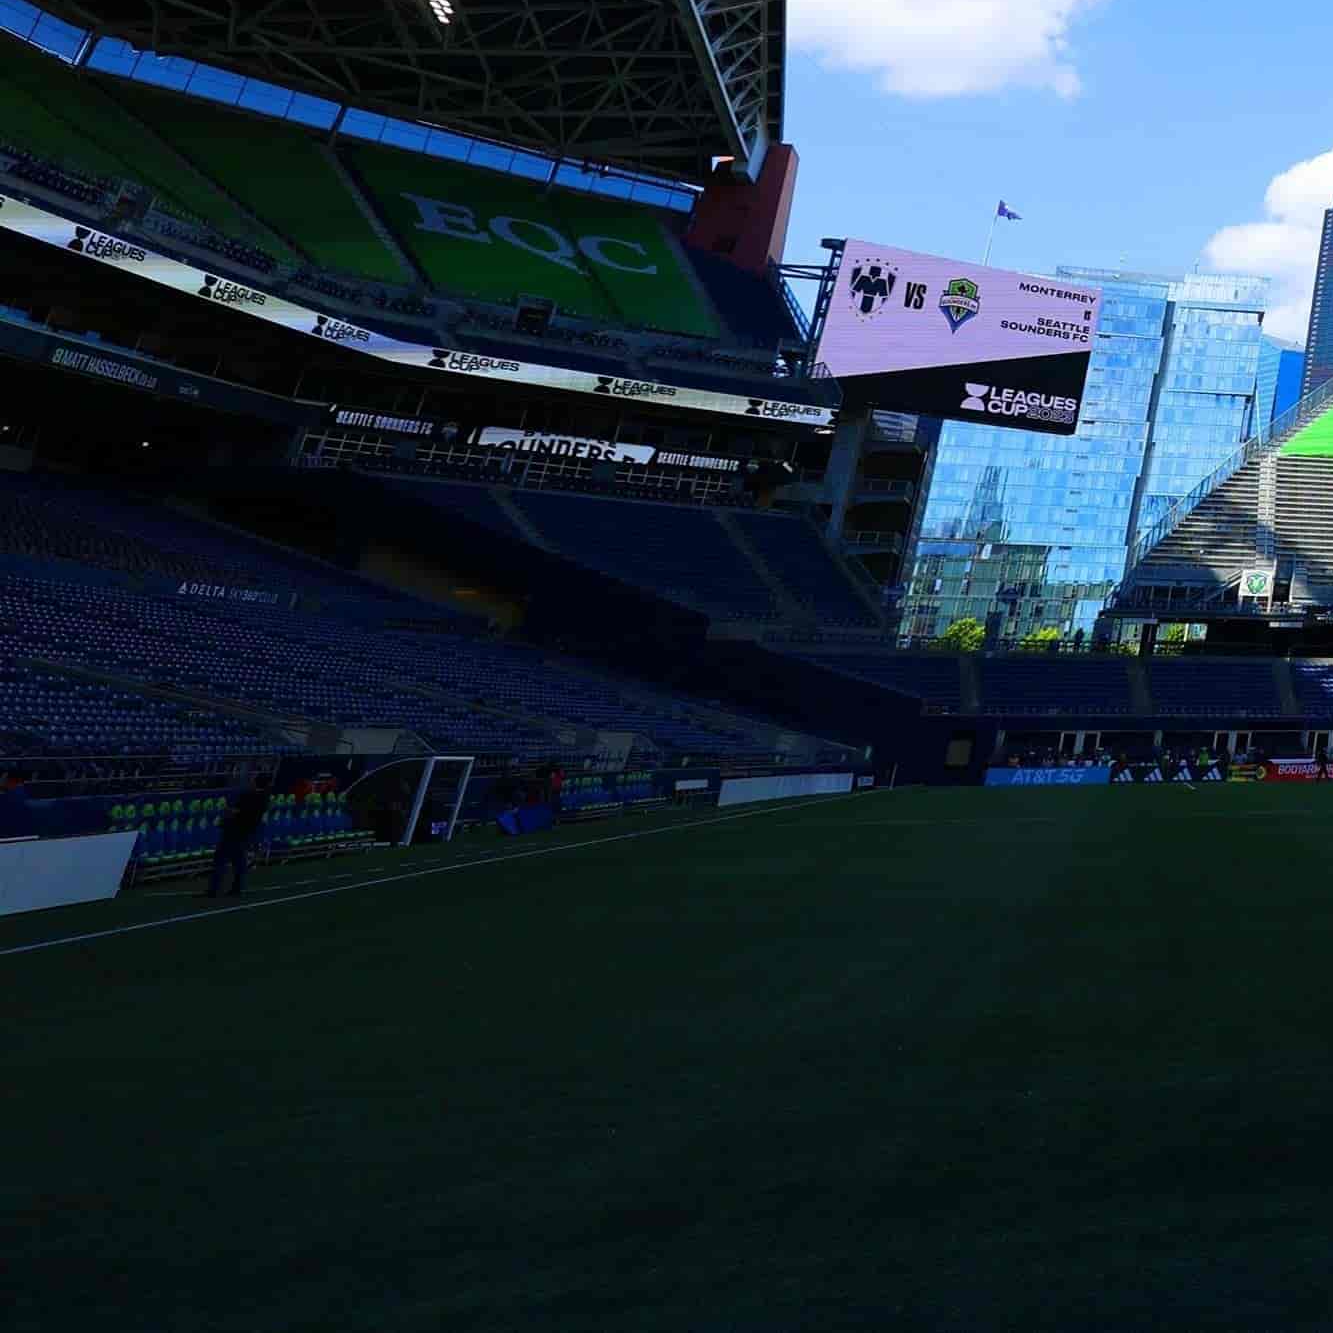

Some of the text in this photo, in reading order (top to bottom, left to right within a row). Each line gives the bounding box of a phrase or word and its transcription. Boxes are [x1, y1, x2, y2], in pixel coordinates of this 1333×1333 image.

[400, 192, 657, 276] EQC
[91, 231, 147, 263] LEAGUES
[217, 279, 267, 306] LEAGUES
[904, 281, 927, 310] VS
[1019, 282, 1097, 305] MONTERREY
[1000, 319, 1089, 343] SOUNDERS FC
[1037, 317, 1090, 335] SEATTLE
[450, 352, 520, 373] LEAGUES
[987, 401, 1028, 417] CUP
[990, 386, 1077, 411] LEAGUES
[1010, 769, 1087, 786] AT&T 5G
